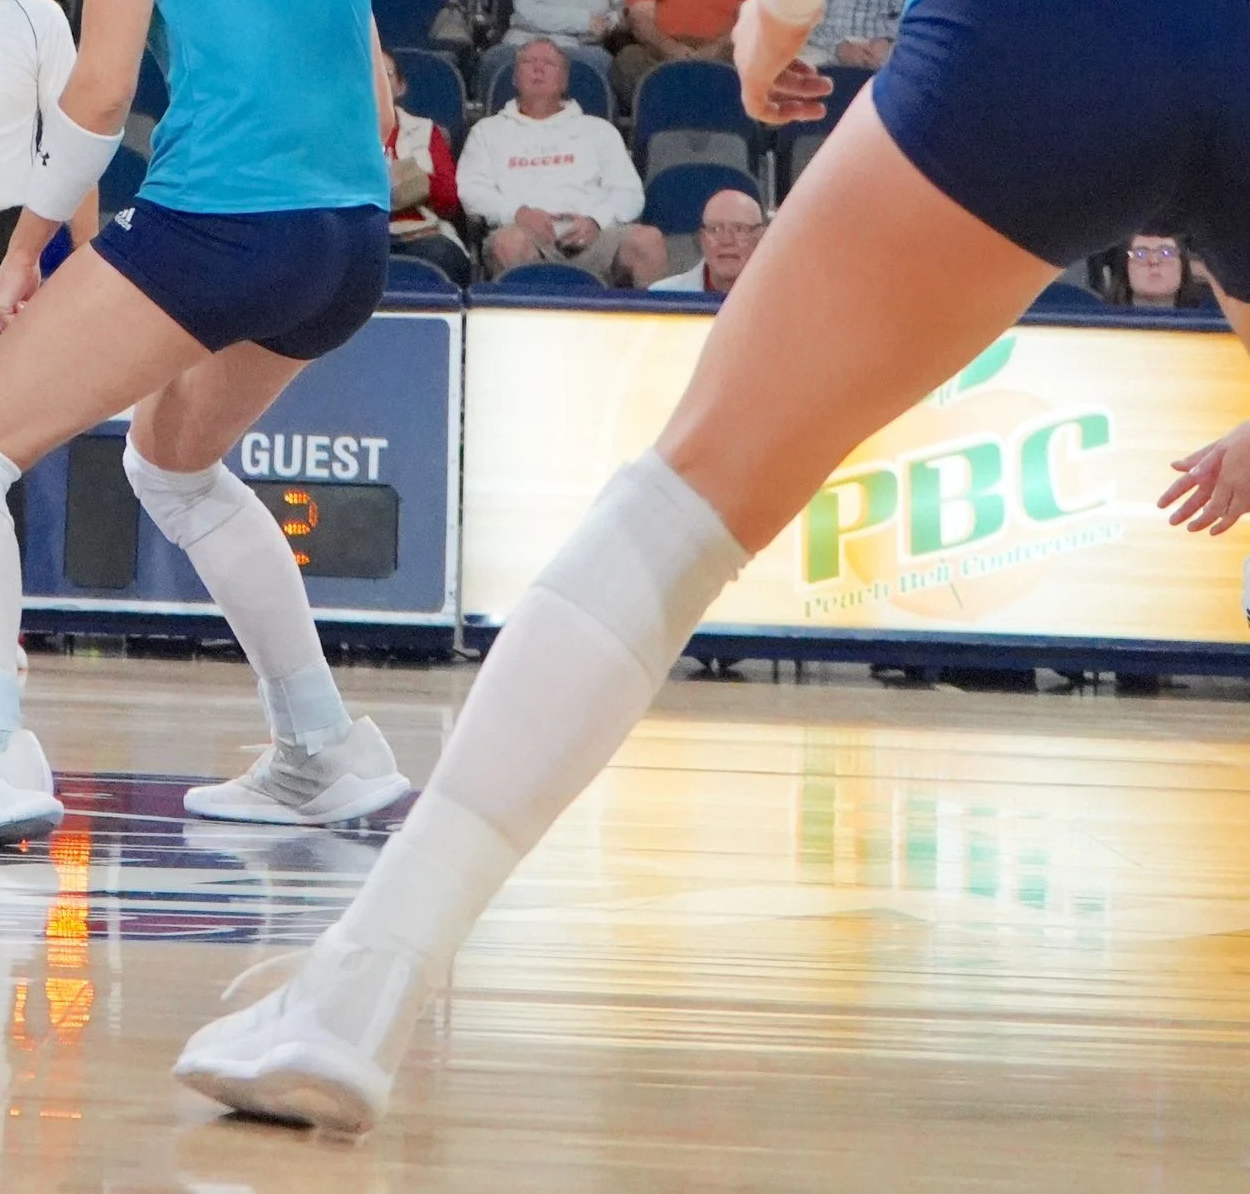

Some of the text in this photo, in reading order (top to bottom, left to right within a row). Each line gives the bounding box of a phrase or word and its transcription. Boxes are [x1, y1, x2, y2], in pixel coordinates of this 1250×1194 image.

[508, 153, 575, 169] SOCCER
[240, 431, 389, 482] GUEST
[803, 411, 1111, 585] PBC
